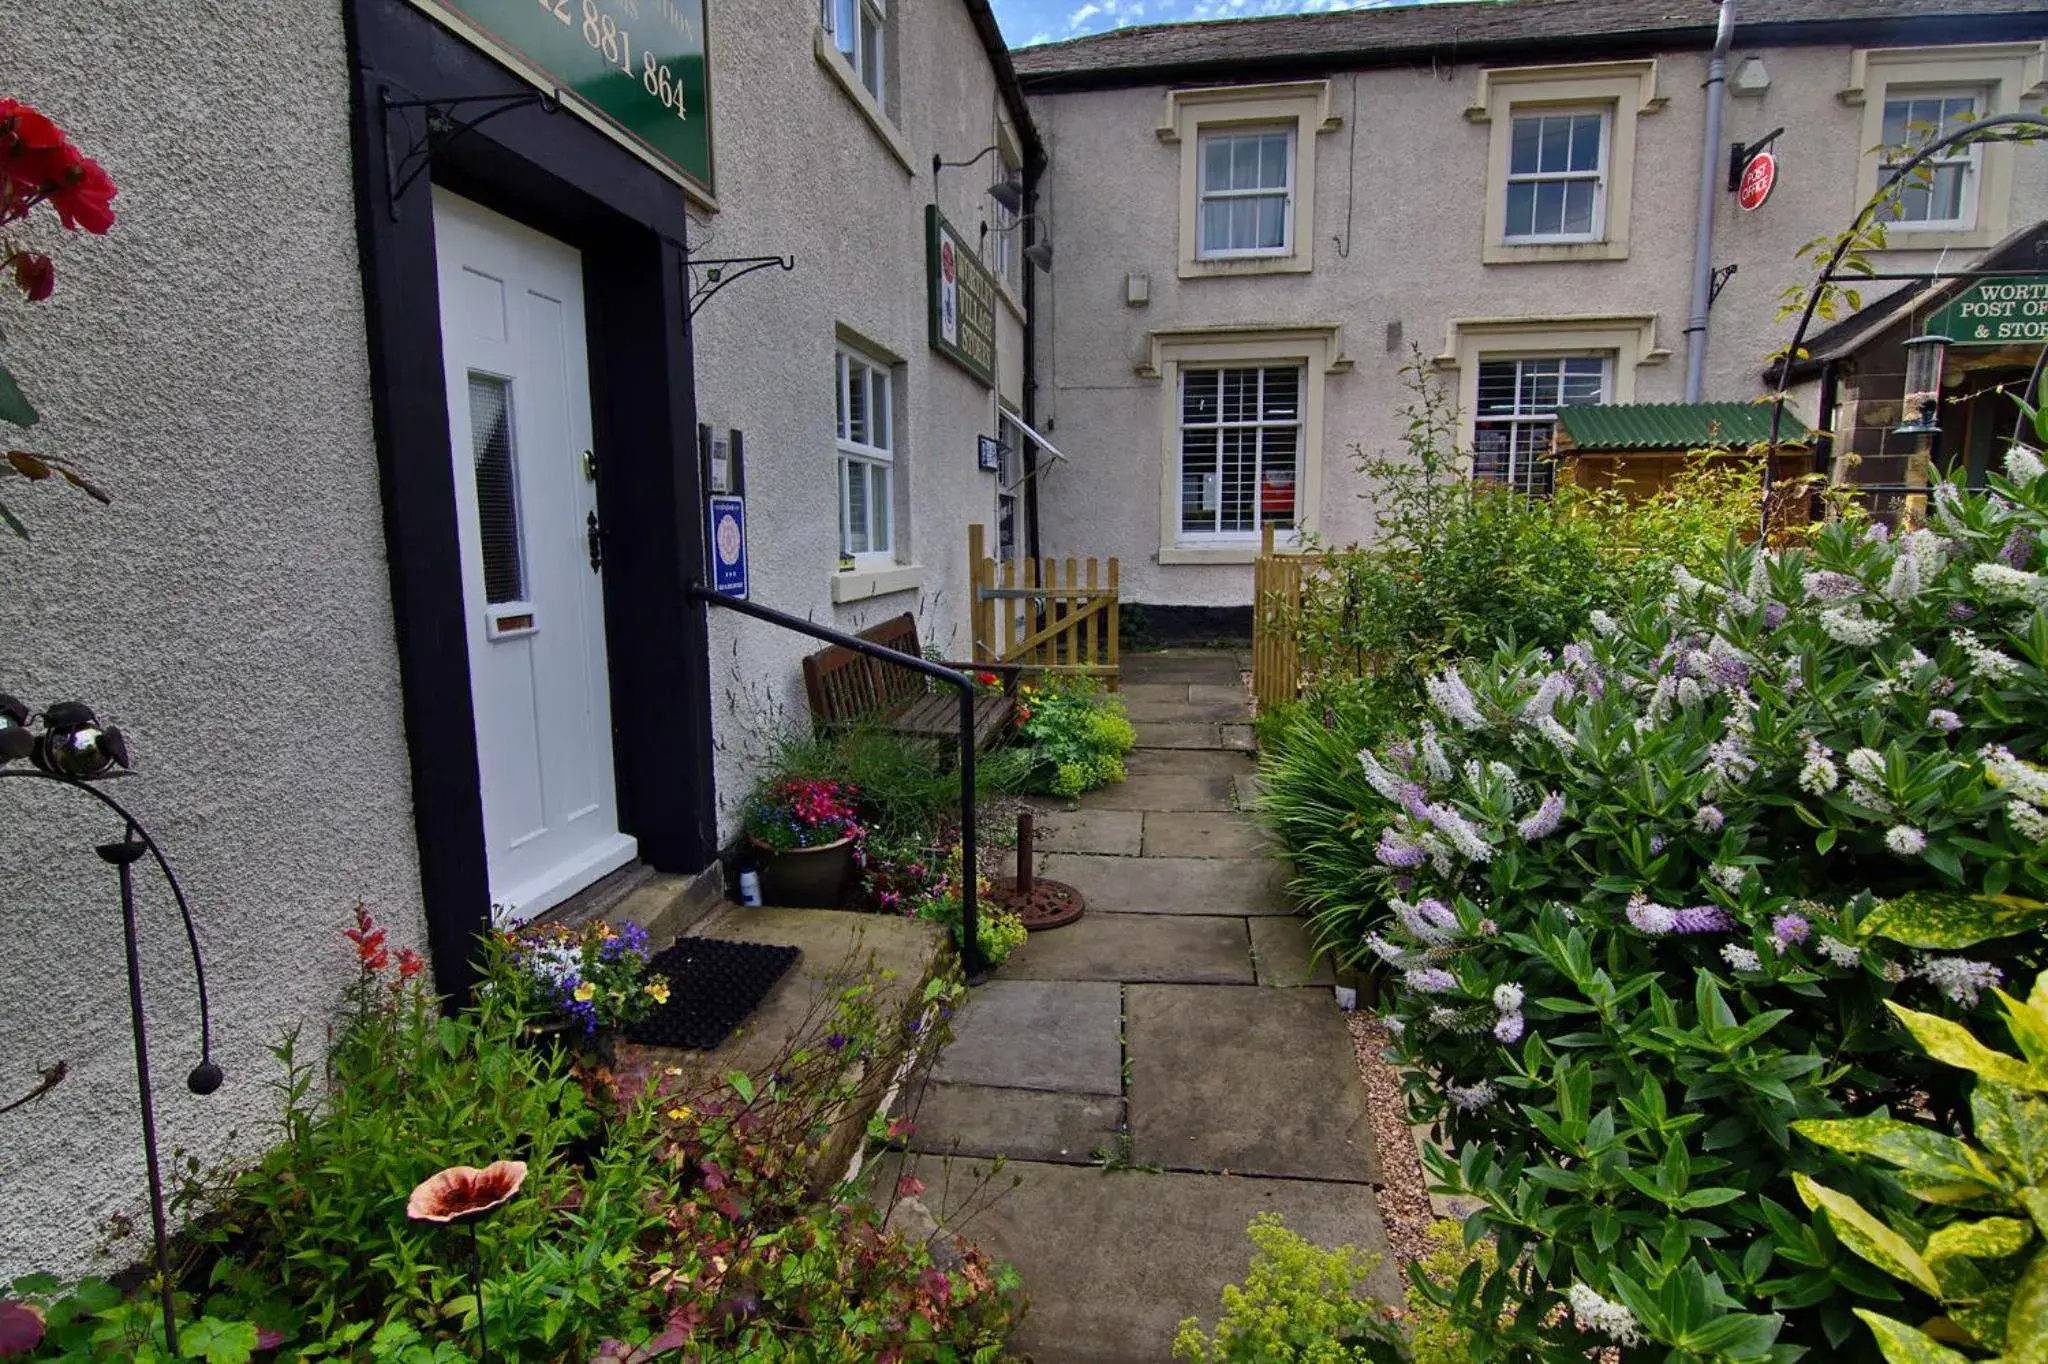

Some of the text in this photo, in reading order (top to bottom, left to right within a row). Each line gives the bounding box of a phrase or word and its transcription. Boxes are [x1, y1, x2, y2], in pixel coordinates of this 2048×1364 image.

[582, 0, 635, 79] 881
[643, 50, 687, 121] 864
[1747, 162, 1768, 184] POST
[1742, 174, 1770, 201] OFFICE
[1960, 301, 2016, 318] POST
[1974, 324, 1991, 338] &
